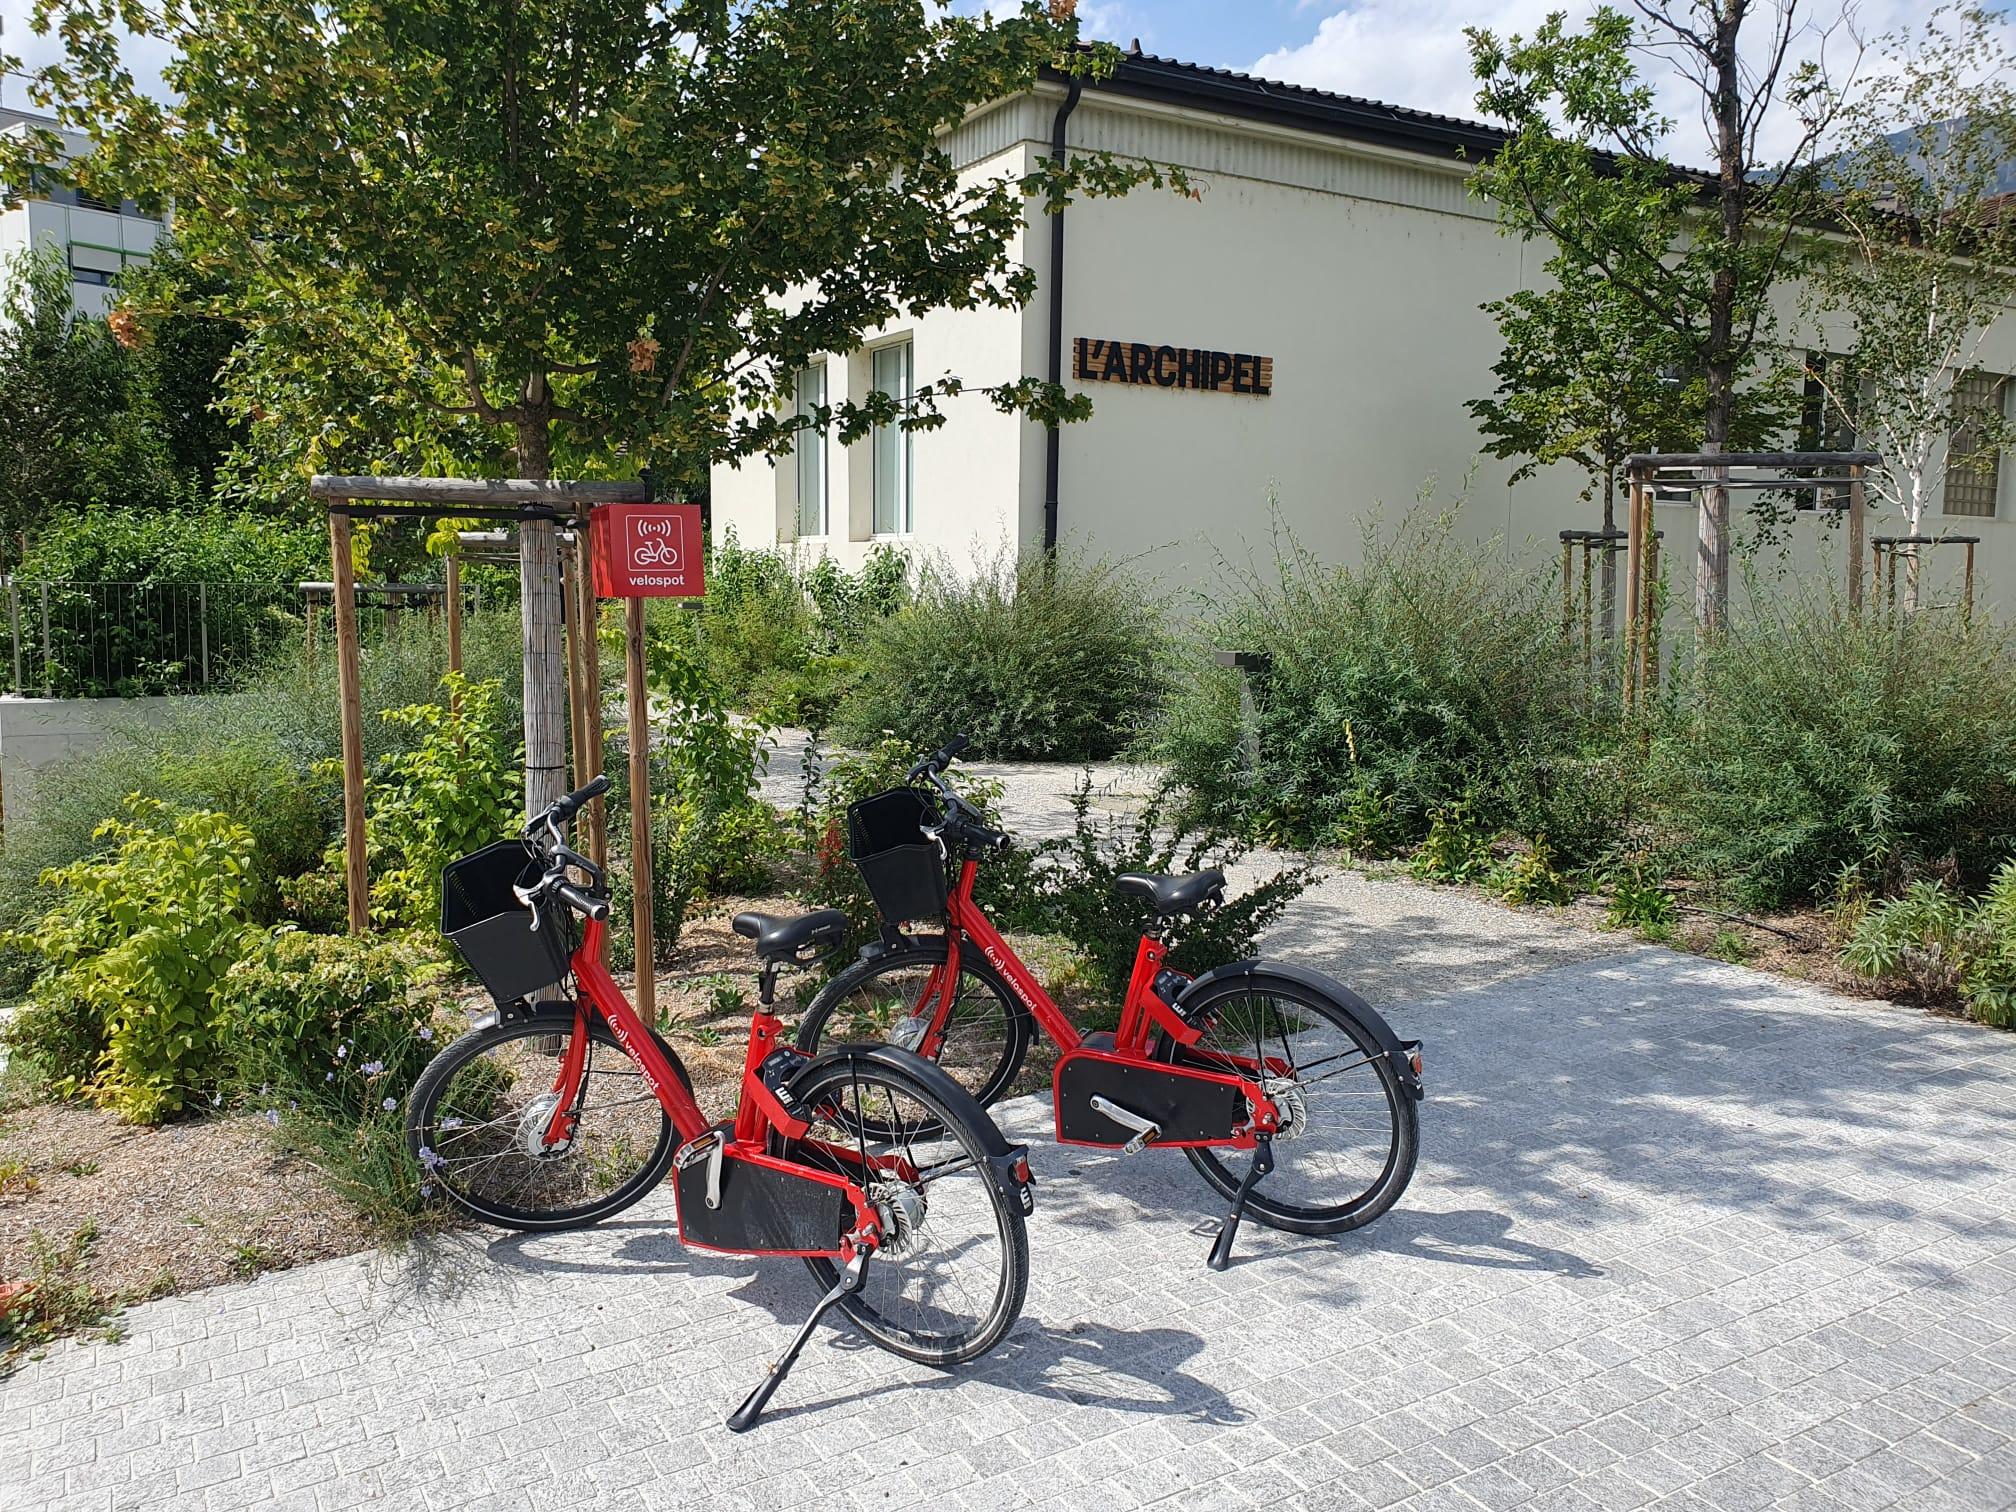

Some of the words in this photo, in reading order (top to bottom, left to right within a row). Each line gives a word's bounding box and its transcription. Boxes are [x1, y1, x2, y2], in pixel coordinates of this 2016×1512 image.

[1079, 337, 1270, 394] L'ARCHIPEL
[629, 574, 685, 587] velospot
[1003, 969, 1037, 1012] velospot
[625, 1041, 660, 1090] velospot
